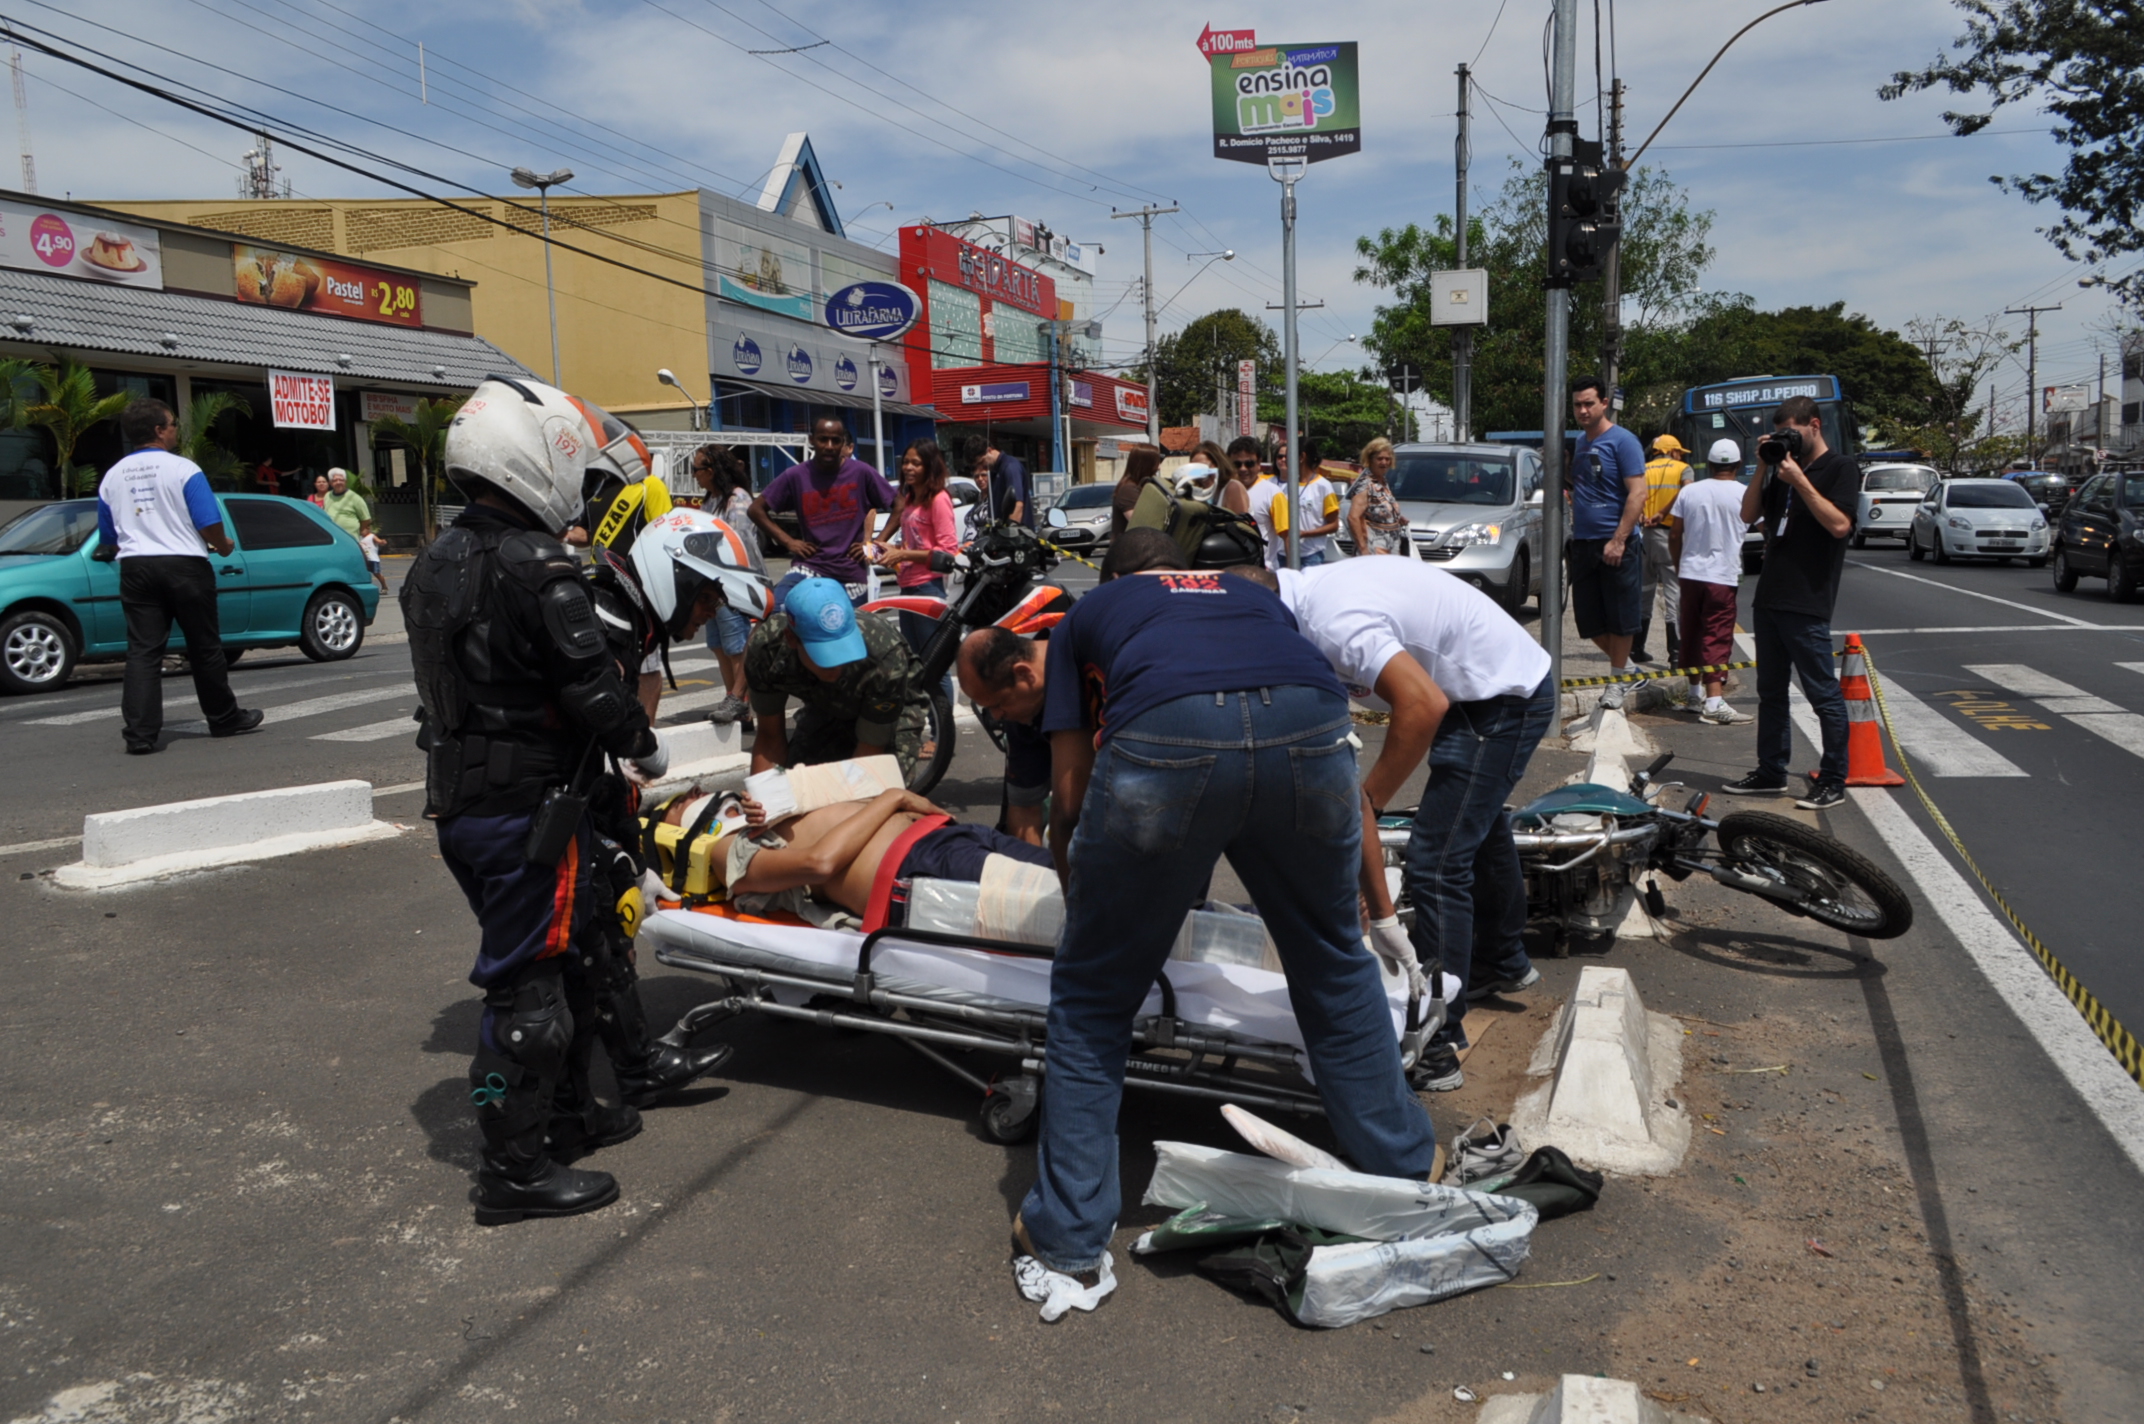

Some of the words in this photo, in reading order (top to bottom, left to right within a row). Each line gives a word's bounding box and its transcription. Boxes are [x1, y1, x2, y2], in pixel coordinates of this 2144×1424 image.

[1210, 34, 1234, 51] 100
[1235, 37, 1254, 49] mts
[1287, 49, 1337, 63] MATEMÁTICA
[1239, 65, 1328, 94] ensina
[1240, 89, 1333, 127] mais
[1219, 139, 1228, 147] R.
[1265, 135, 1300, 145] Pacheco
[1309, 134, 1332, 145] Silva,
[1334, 133, 1354, 143] 1419
[37, 233, 72, 257] 4,90
[327, 276, 364, 300] Pastel
[371, 288, 378, 298] R$
[379, 281, 415, 316] 2,80
[274, 375, 330, 403] ADMITE-SE
[275, 400, 330, 425] MOTOBOY
[553, 434, 579, 459] 192
[560, 427, 584, 450] SAMU
[1162, 578, 1223, 590] 192
